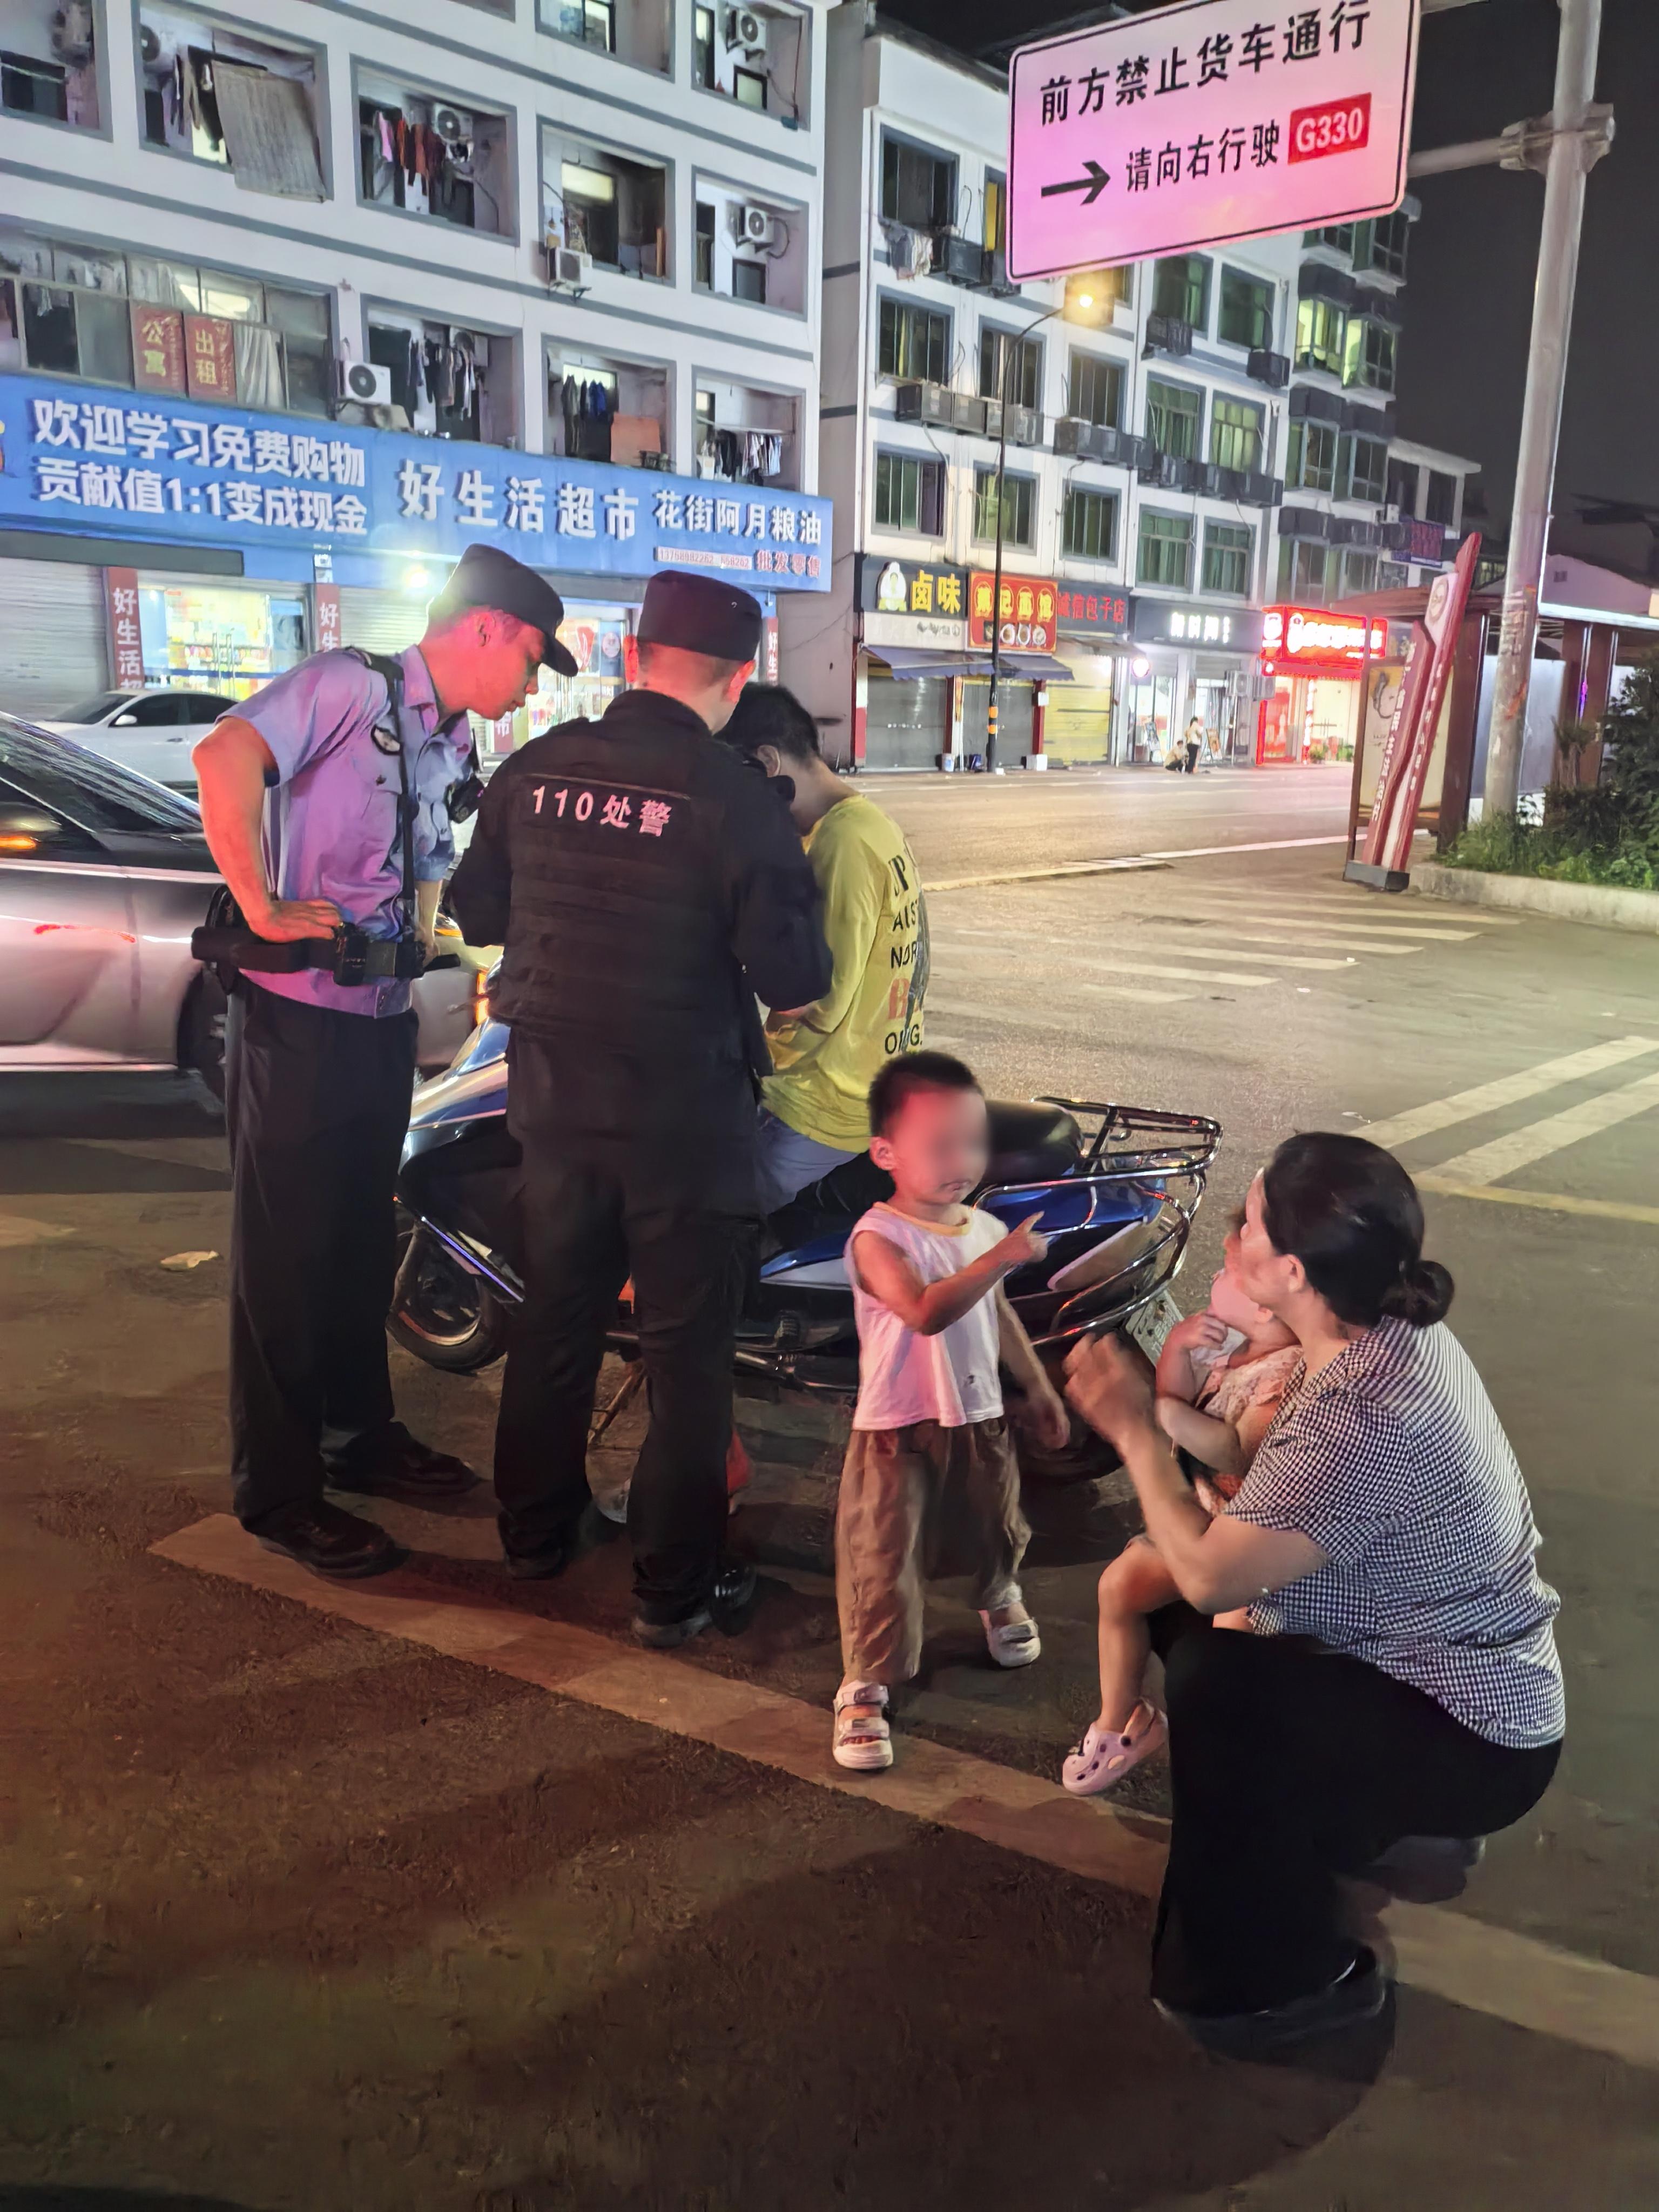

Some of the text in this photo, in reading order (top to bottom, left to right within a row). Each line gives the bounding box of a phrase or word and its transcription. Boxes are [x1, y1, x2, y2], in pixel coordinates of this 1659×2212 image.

[1040, 1, 1371, 126] 前方禁止货车通行
[1125, 107, 1364, 193] 请向右行驶 G330
[195, 328, 218, 385] 出租
[33, 399, 365, 487] 欢迎学习免费购物
[36, 456, 368, 535] 贡献值1:1变成现金
[399, 458, 639, 541] 好生活超市
[655, 489, 821, 545] 花街阿月粮油
[912, 570, 960, 613] 卤味
[533, 786, 672, 837] 110处警
